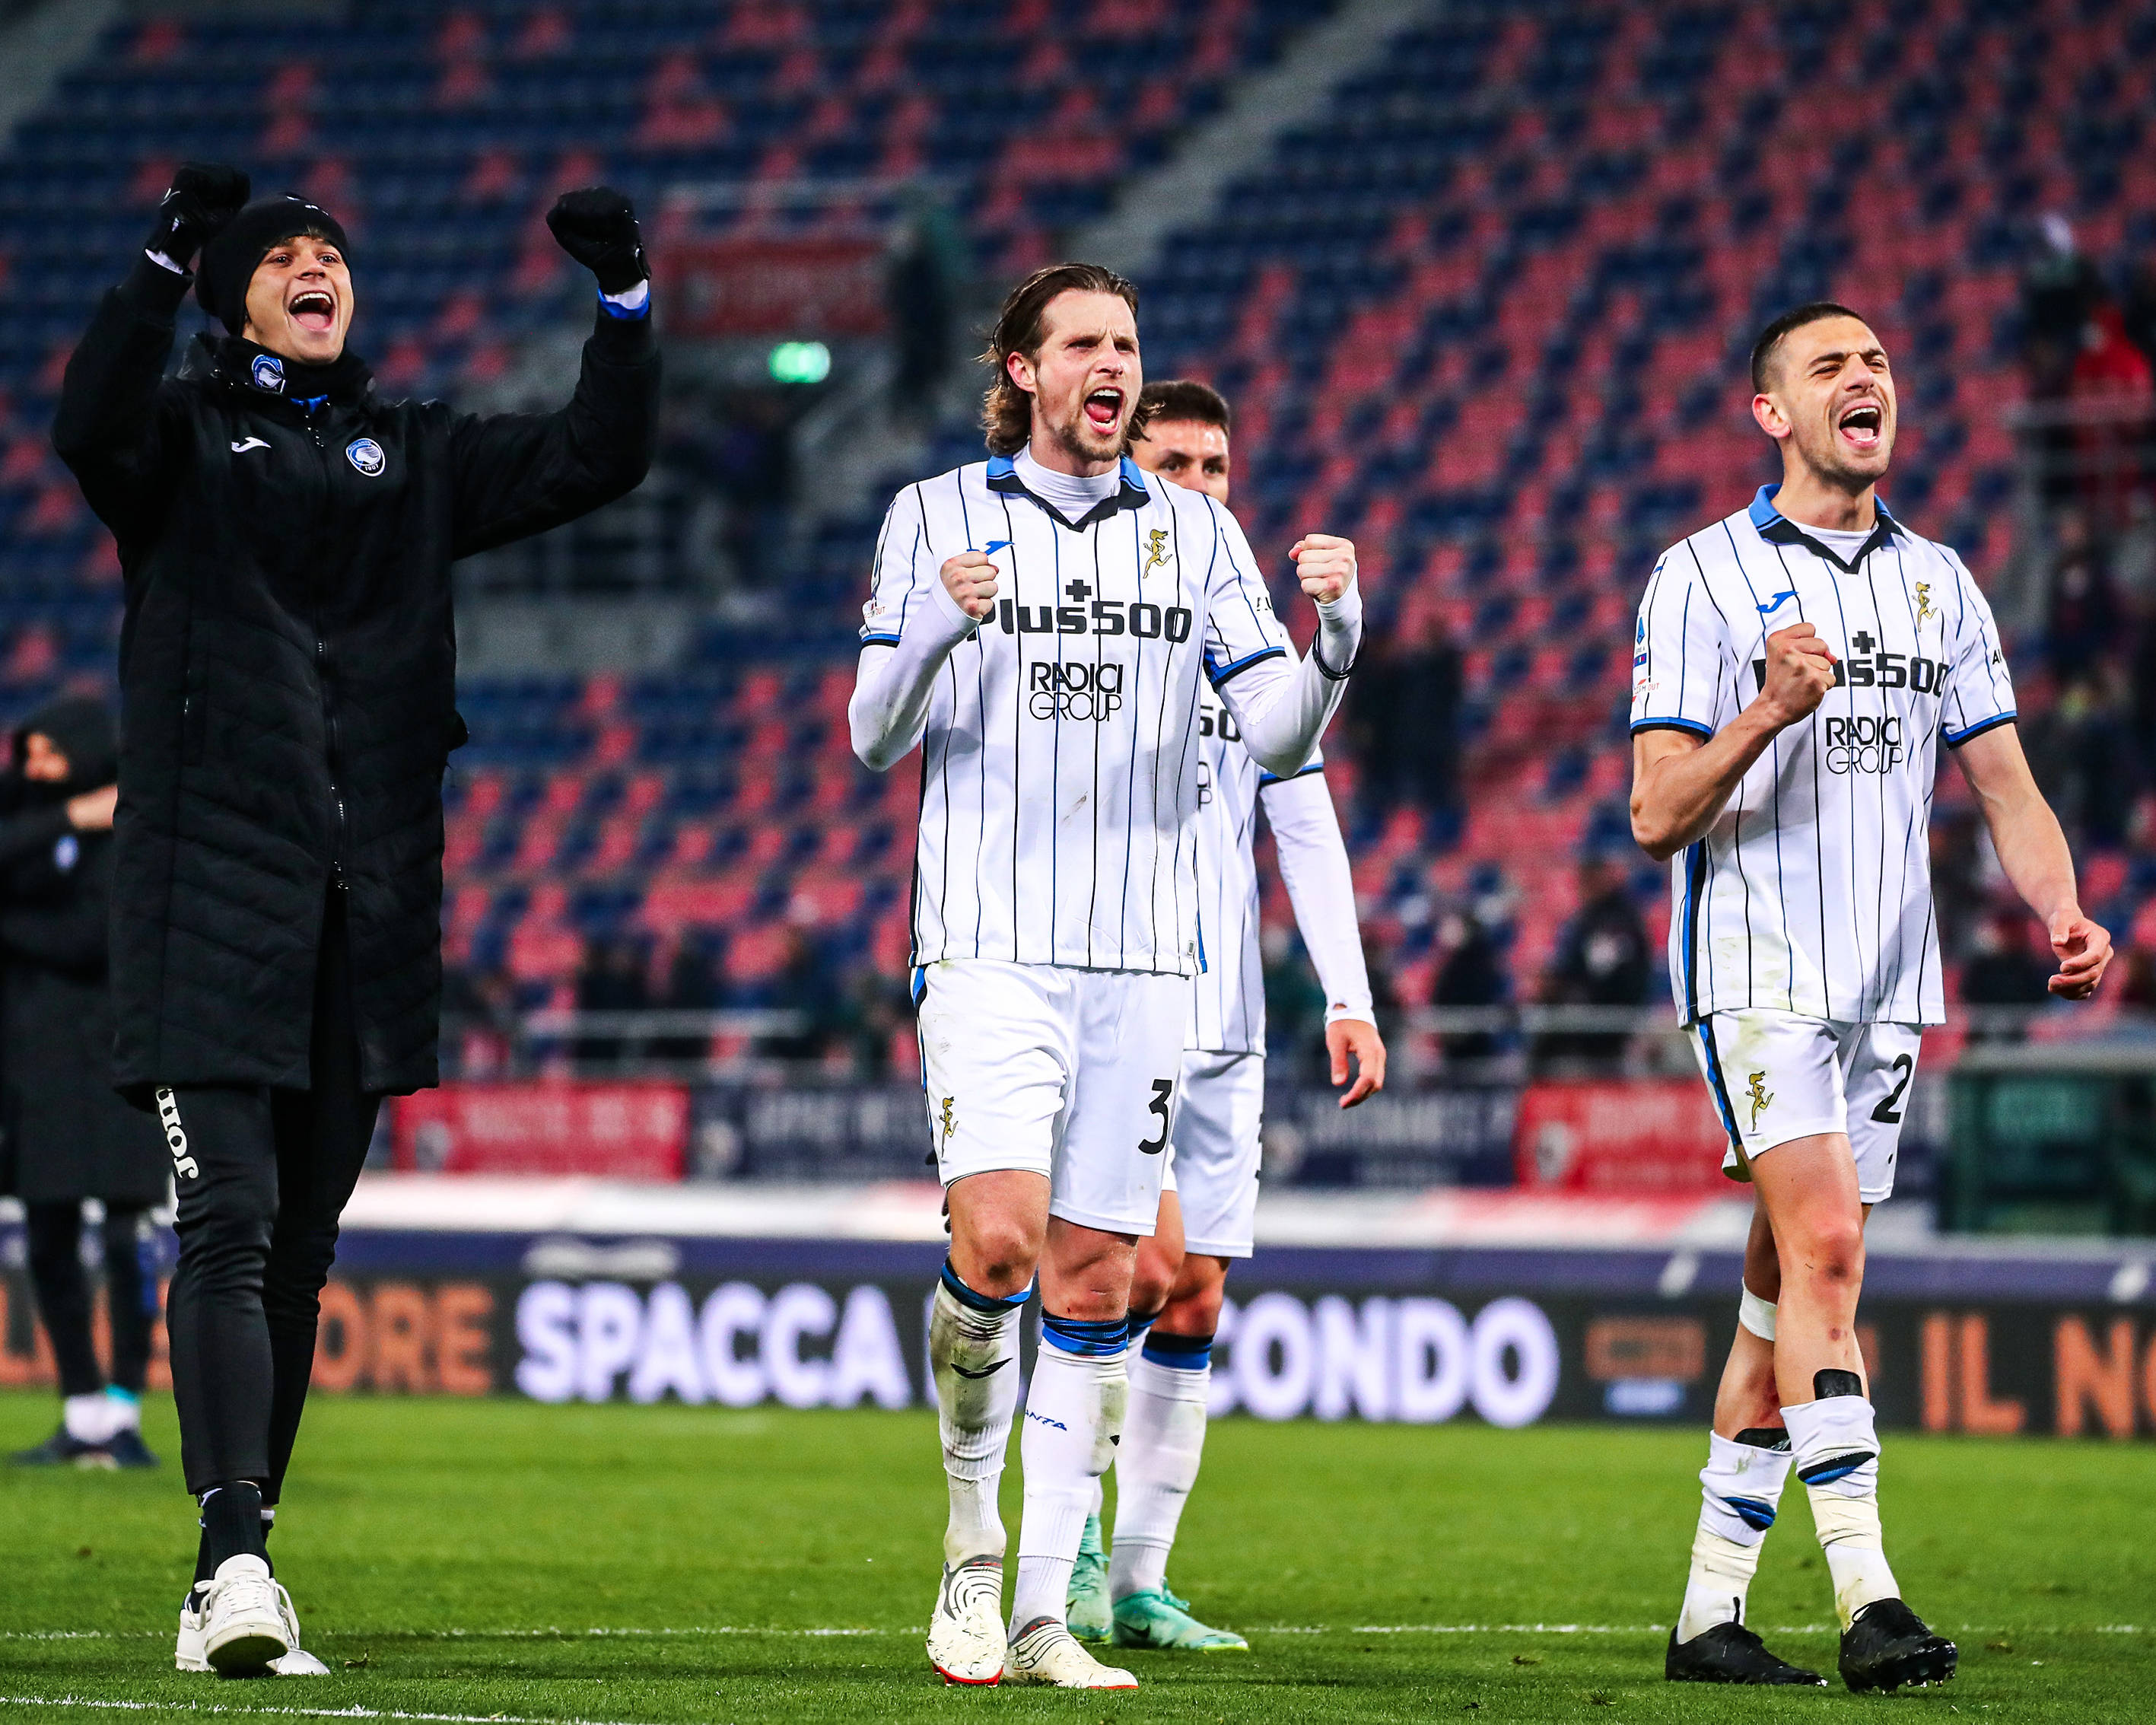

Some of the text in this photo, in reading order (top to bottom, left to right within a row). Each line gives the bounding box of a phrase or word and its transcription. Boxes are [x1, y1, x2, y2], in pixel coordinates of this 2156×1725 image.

[1030, 661, 1124, 694] RADICI
[1752, 653, 1949, 698] s500
[1029, 691, 1122, 721] GROUP
[1826, 717, 1902, 746] RADICI
[1826, 746, 1903, 775] GROUP
[155, 1088, 199, 1179] Jom
[1138, 1079, 1172, 1154] 3
[313, 1281, 494, 1397] ORE
[514, 1279, 912, 1409] SPACCA
[1922, 1313, 2156, 1437] IL N
